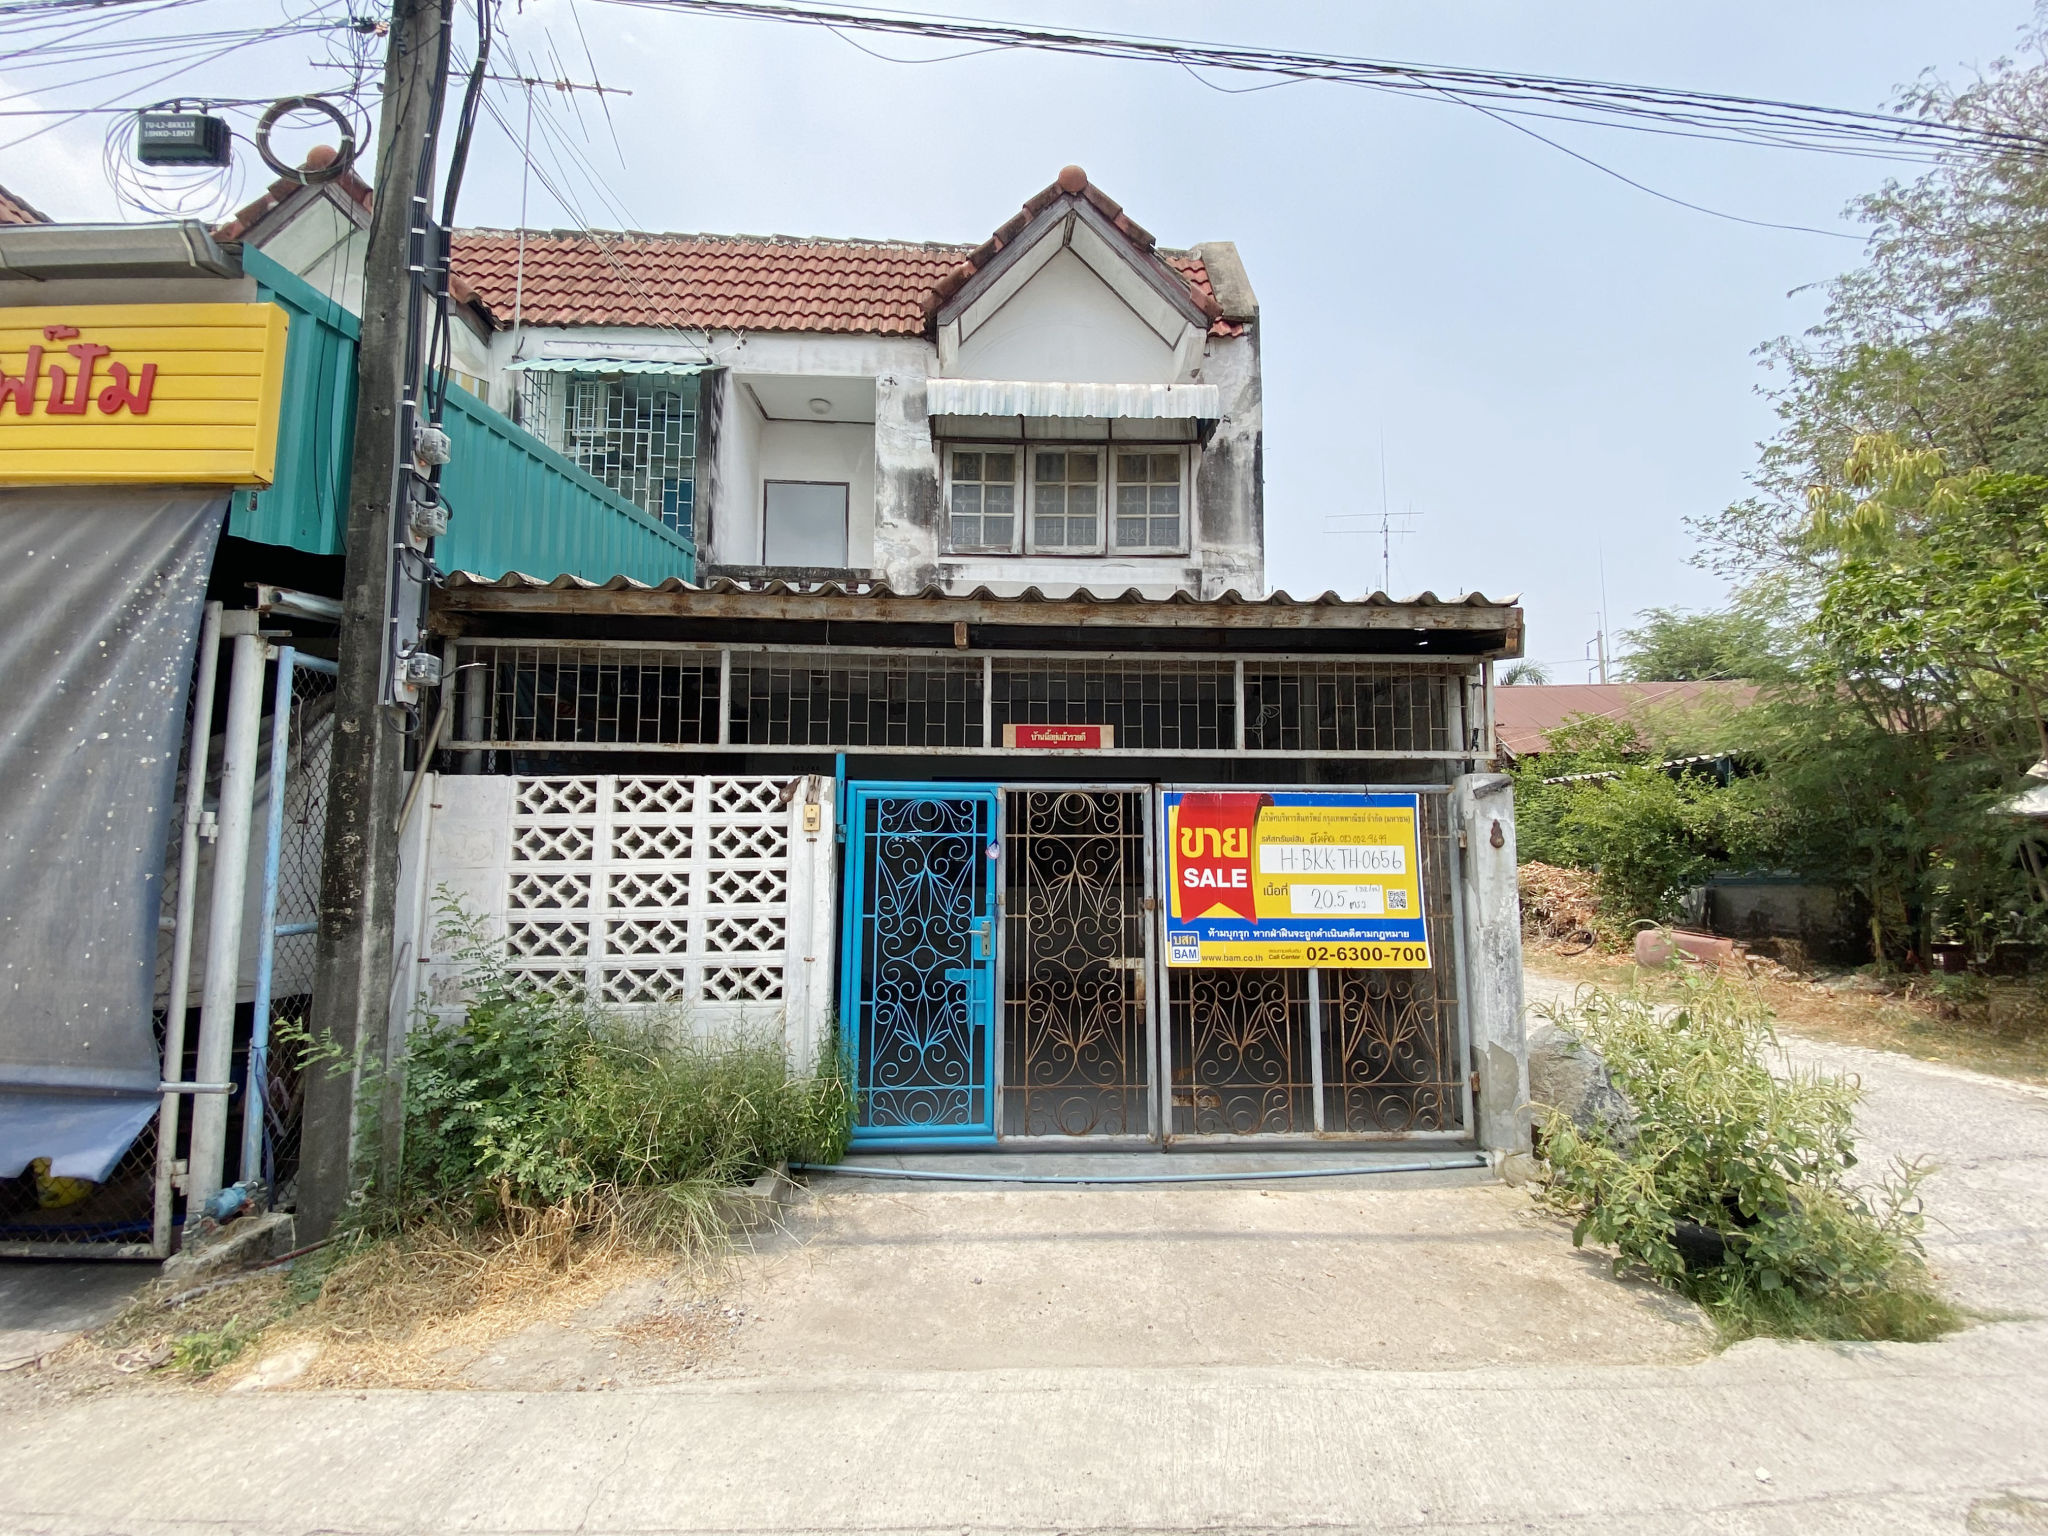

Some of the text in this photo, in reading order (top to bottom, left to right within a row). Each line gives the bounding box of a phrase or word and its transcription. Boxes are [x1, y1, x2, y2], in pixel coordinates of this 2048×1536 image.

[1181, 827, 1248, 858] ขาย
[1184, 868, 1248, 888] SALE
[1263, 884, 1289, 896] เนื้อที่
[1311, 888, 1348, 909] 20.5
[1173, 935, 1197, 945] บสก
[1208, 928, 1249, 940] ห้ามบุกรุก
[1174, 947, 1198, 959] BAM
[1202, 952, 1264, 961] www.bam.co.th
[1306, 945, 1427, 961] 02-6300-700
